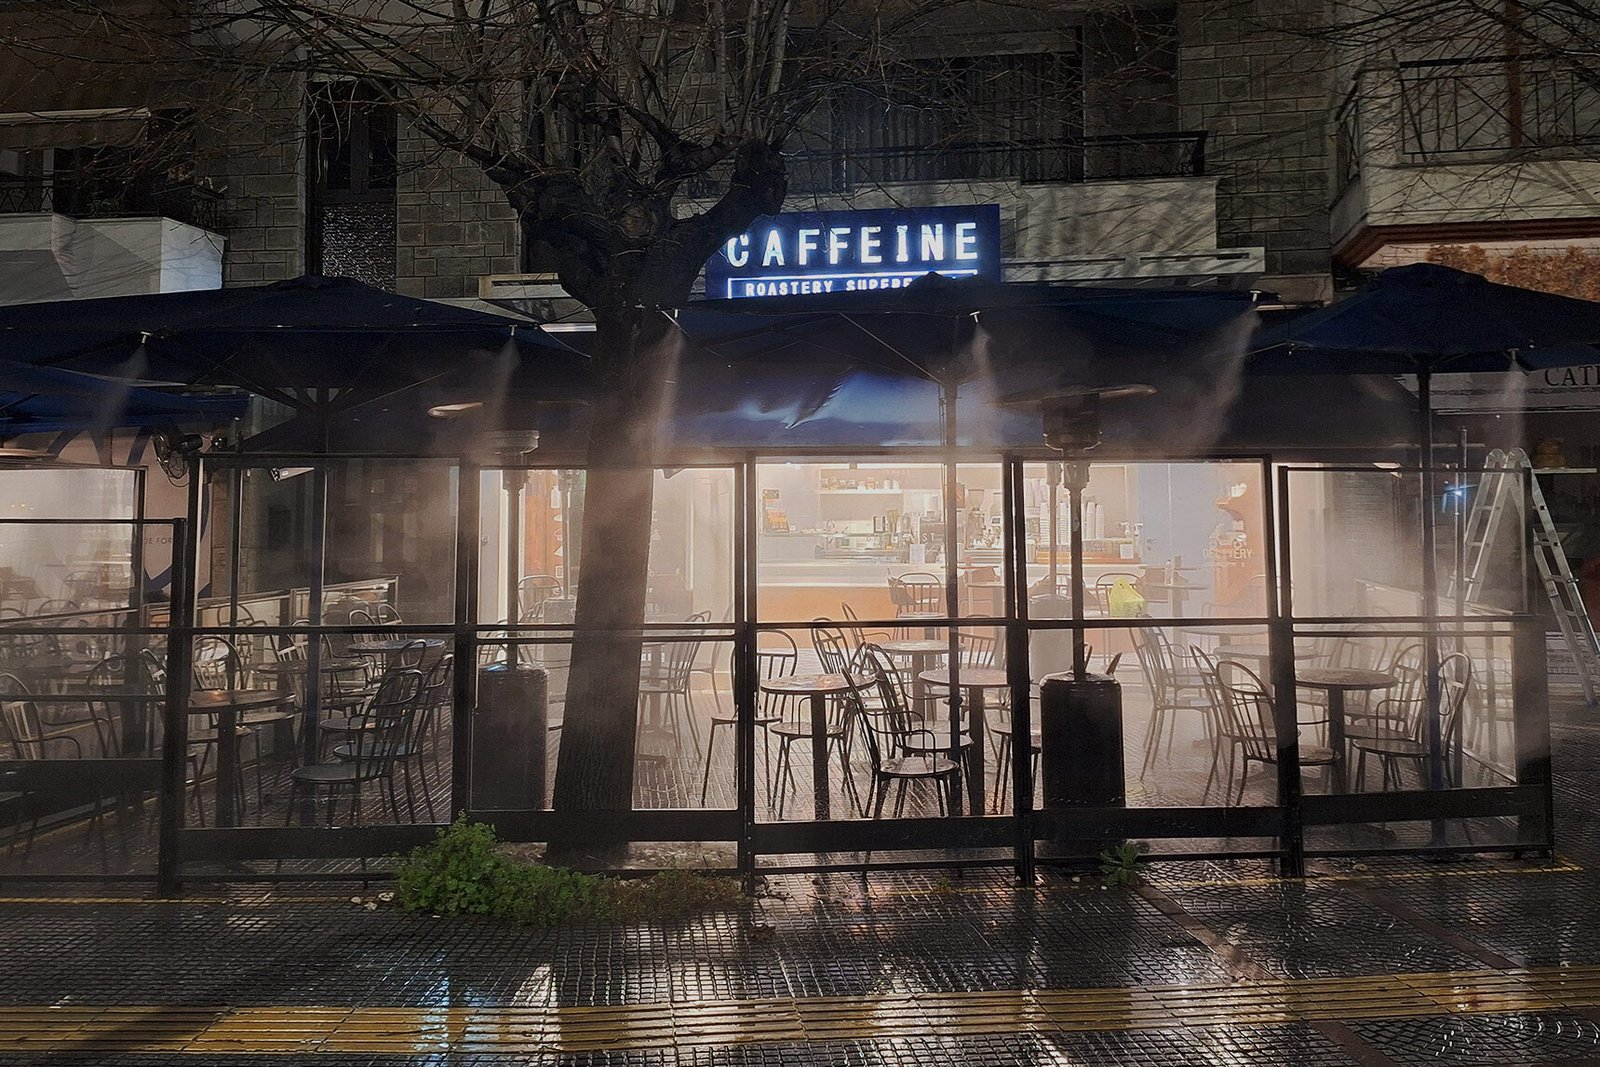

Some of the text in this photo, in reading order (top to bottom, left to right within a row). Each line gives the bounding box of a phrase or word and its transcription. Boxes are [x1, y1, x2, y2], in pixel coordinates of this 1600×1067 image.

[727, 222, 978, 268] CAFFEINE
[745, 280, 833, 297] ROASTERY
[1202, 548, 1253, 559] DELVERY
